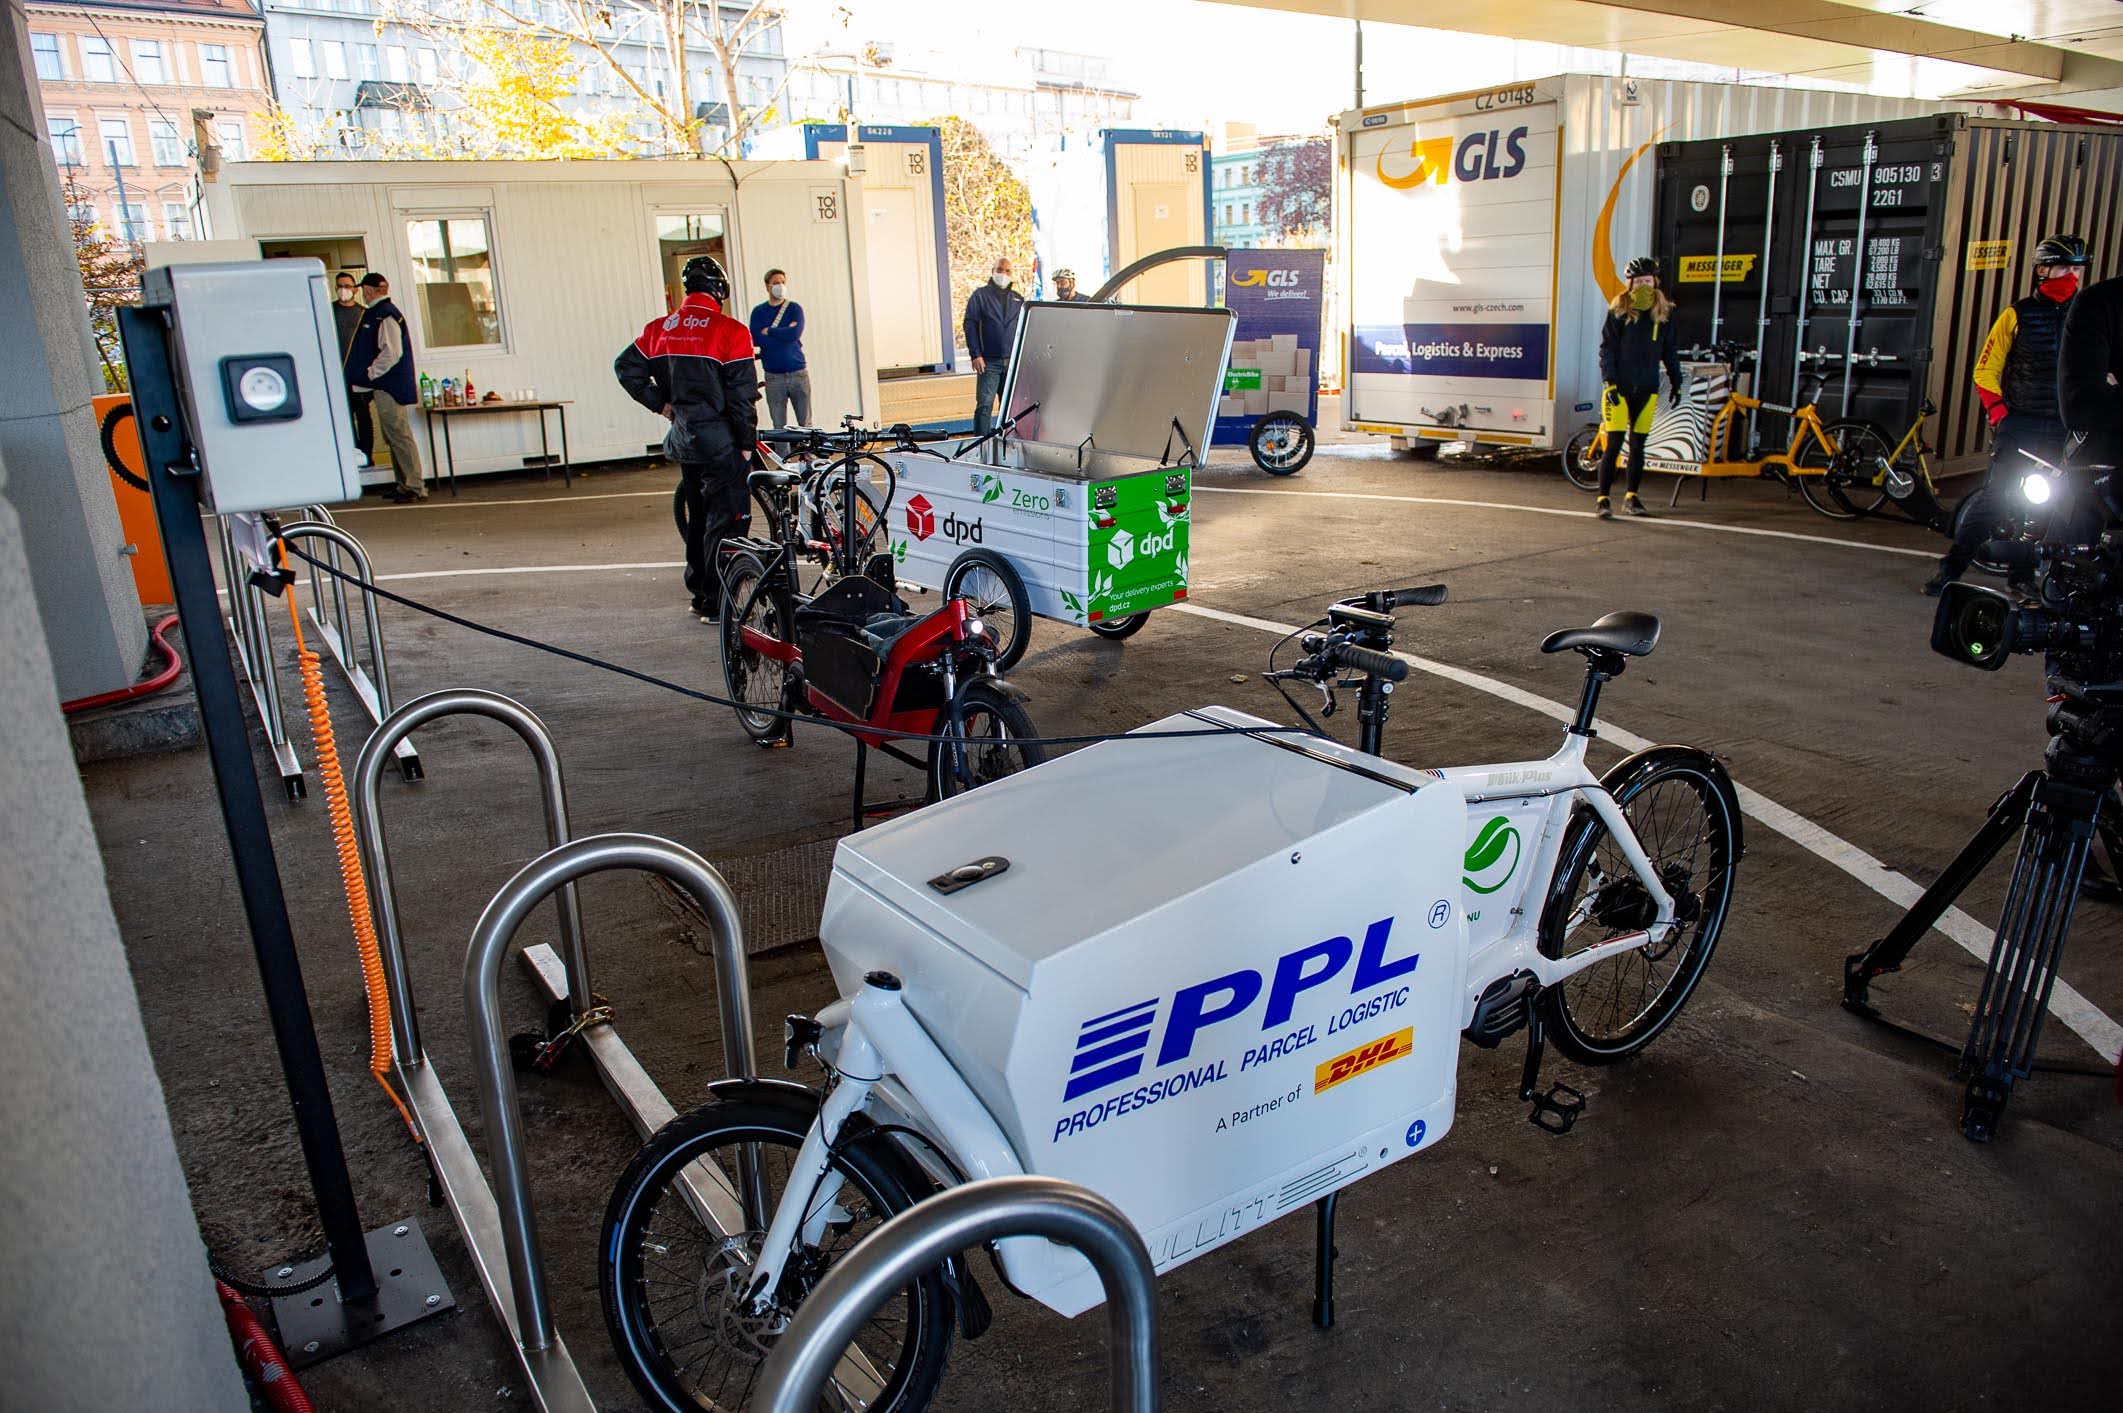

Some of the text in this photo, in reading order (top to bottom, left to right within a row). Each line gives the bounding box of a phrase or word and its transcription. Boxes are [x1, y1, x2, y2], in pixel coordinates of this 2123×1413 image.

[1475, 85, 1534, 110] CZ 0148
[1455, 126, 1528, 182] GLS
[1831, 164, 1941, 187] CSMU 905130 3
[1873, 189, 1903, 206] 22G1
[1814, 240, 1837, 256] MAX.
[1839, 240, 1854, 256] GR.
[1814, 257, 1836, 273] TARE
[1267, 269, 1299, 287] GLS
[1812, 274, 1831, 289] NET
[1812, 290, 1828, 304] CU.
[1831, 289, 1852, 304] CAP.
[1452, 303, 1524, 314] www.gls-czech.com
[683, 315, 710, 330] dpd
[1412, 342, 1460, 360] Logistics
[1462, 342, 1473, 357] &
[1476, 343, 1523, 362] Express
[1659, 462, 1699, 472] MESSENGER
[1012, 489, 1049, 511] Zero
[943, 512, 983, 546] dpd
[1140, 527, 1174, 559] dpd
[1109, 580, 1174, 601] Your delivery experts
[1109, 601, 1131, 613] dpd.cz
[1155, 916, 1420, 1068] PPL
[1053, 986, 1410, 1142] PROFESSIONAL PARCEL LOGISTIC
[1215, 1037, 1400, 1133] A Partner of DHL
